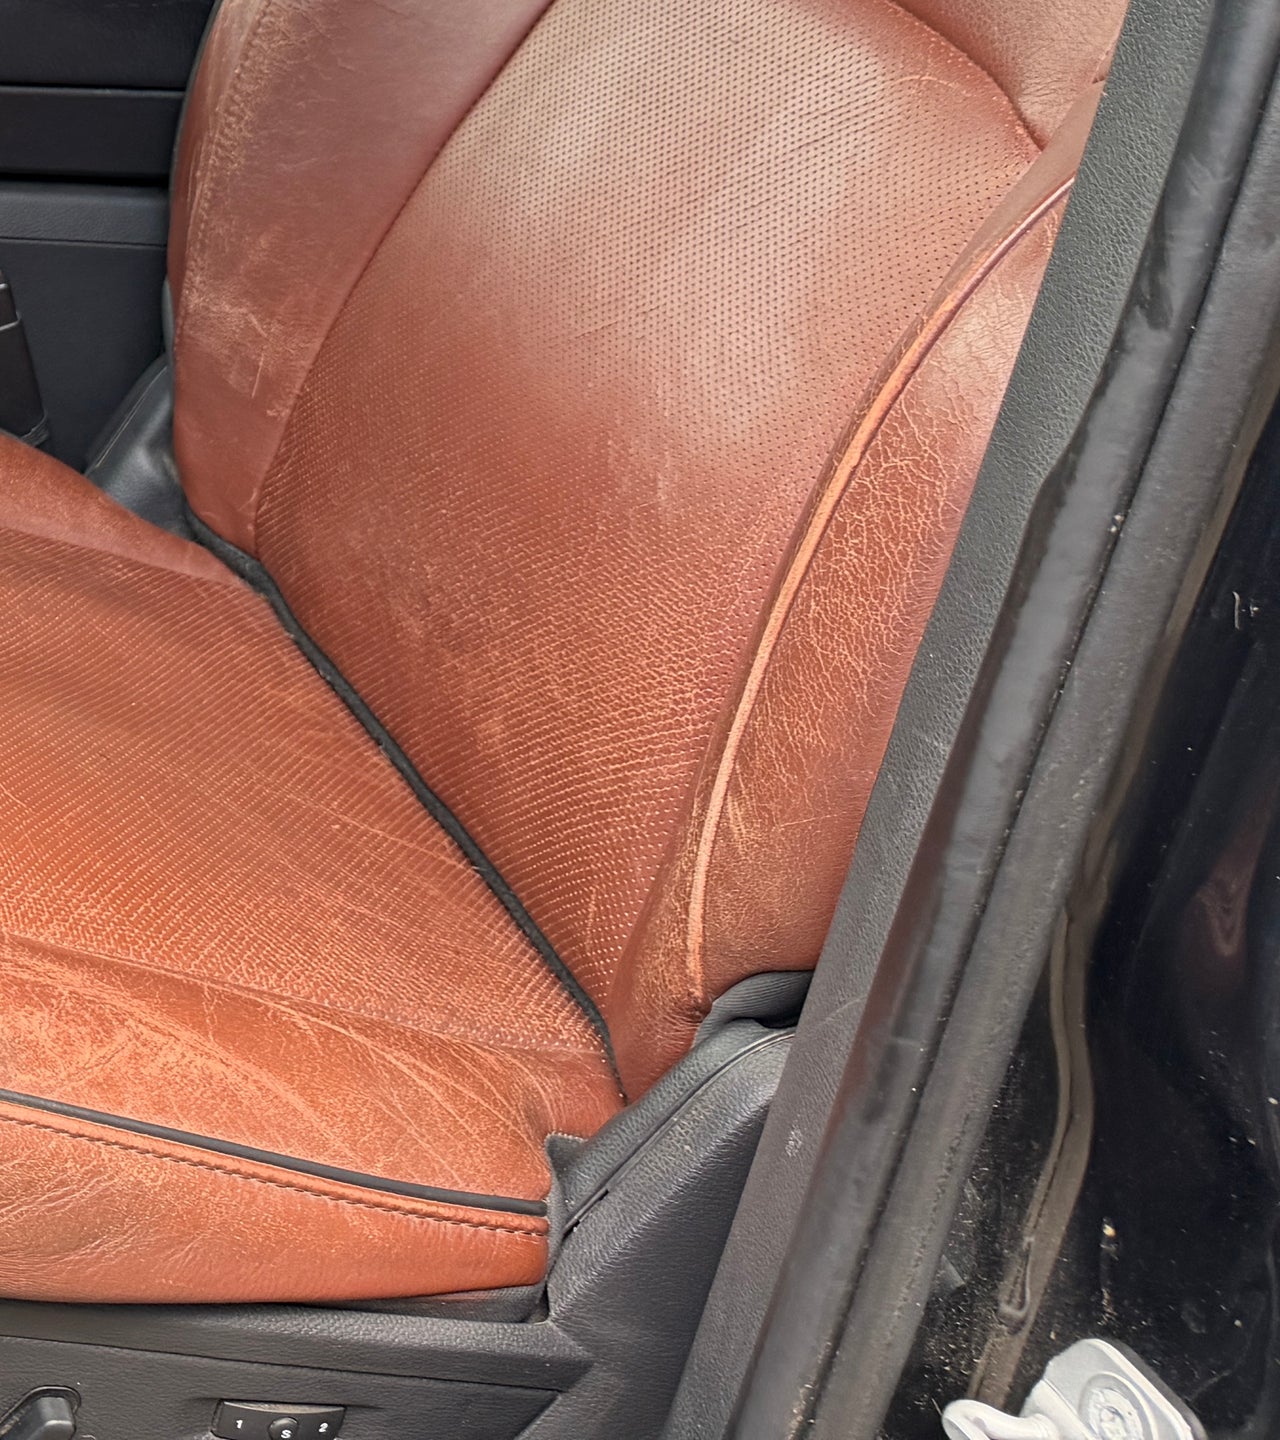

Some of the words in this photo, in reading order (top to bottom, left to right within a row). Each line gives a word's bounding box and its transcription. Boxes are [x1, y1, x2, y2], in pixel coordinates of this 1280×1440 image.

[236, 1419, 243, 1429] 1
[280, 1429, 292, 1439] S
[318, 1422, 329, 1433] 2
